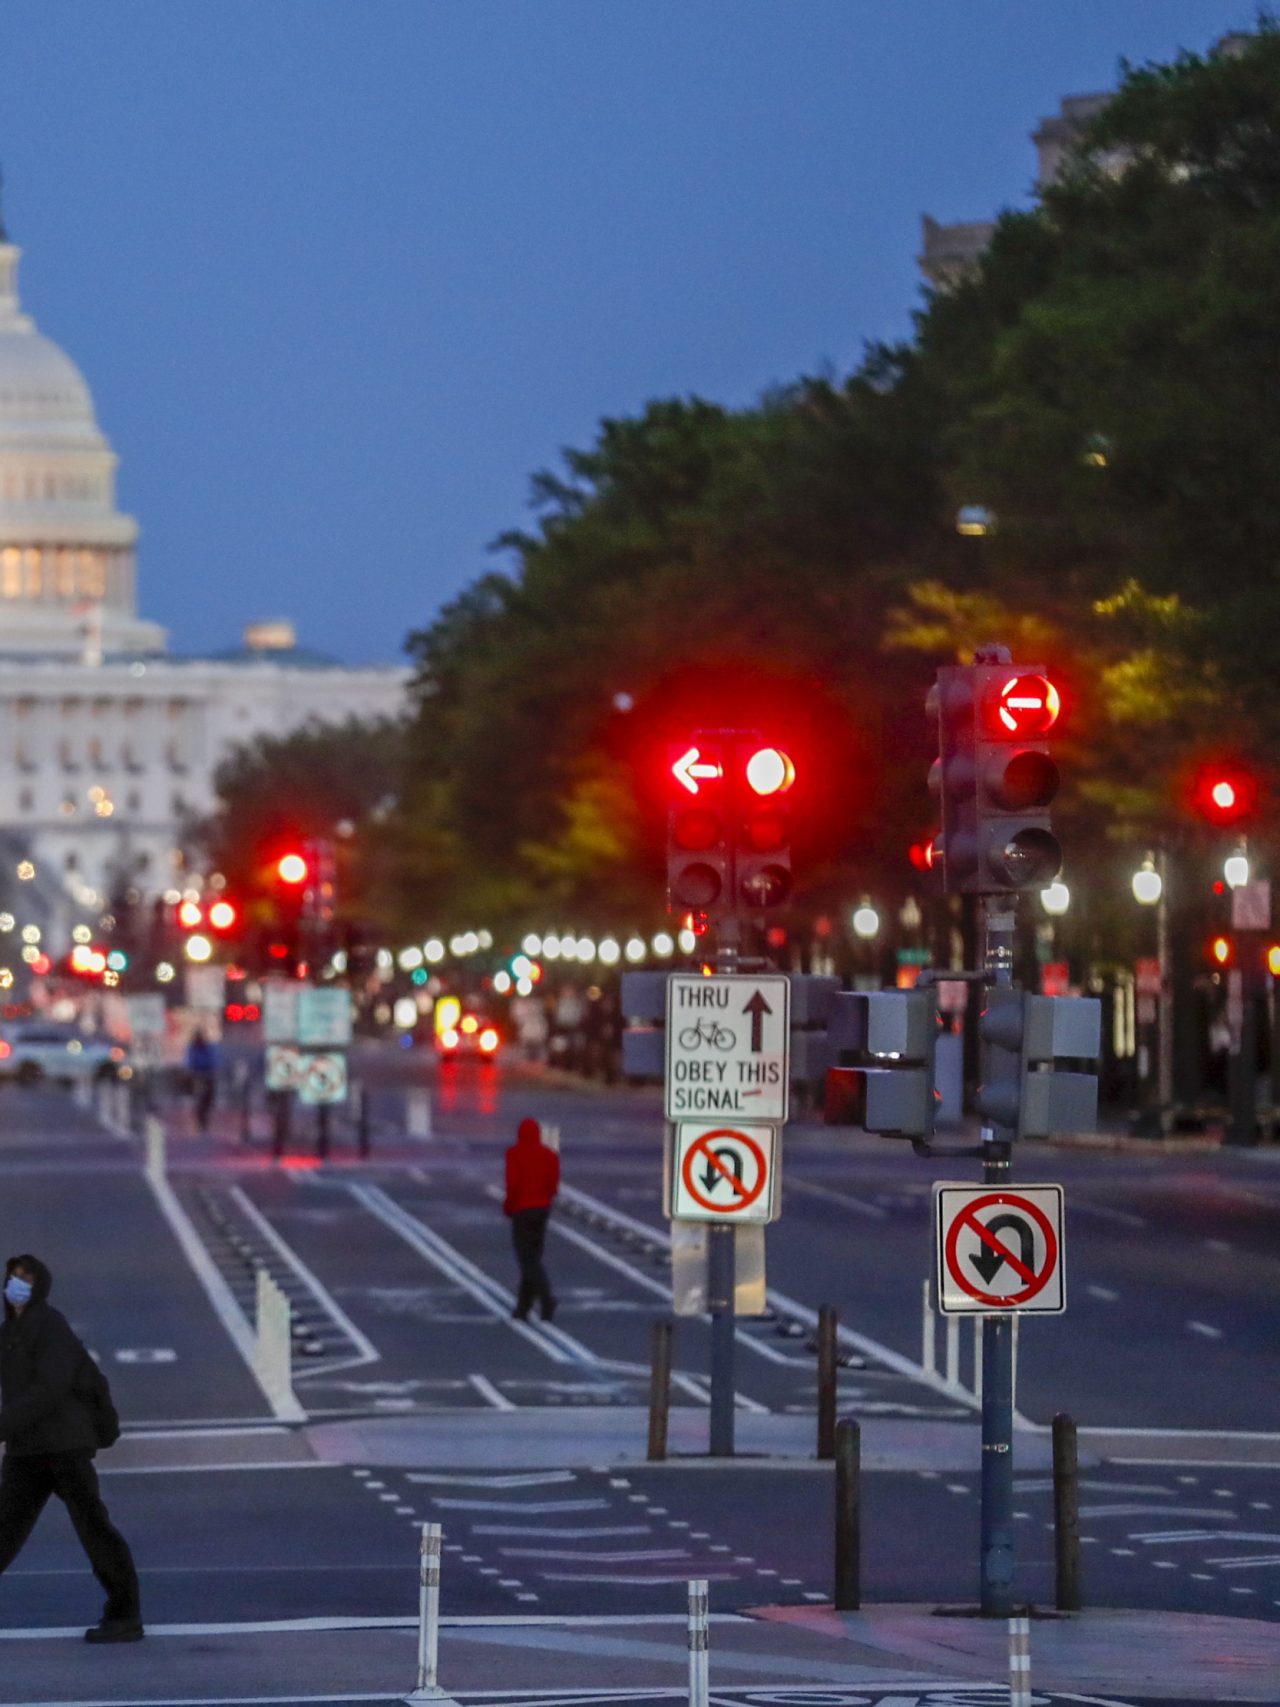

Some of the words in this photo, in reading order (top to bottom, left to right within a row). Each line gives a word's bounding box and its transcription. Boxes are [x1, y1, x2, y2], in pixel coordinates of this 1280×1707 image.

[678, 986, 729, 1008] THRU
[675, 1060, 727, 1082] OBEY
[736, 1061, 780, 1084] THIS
[675, 1087, 745, 1111] SIGNAL
